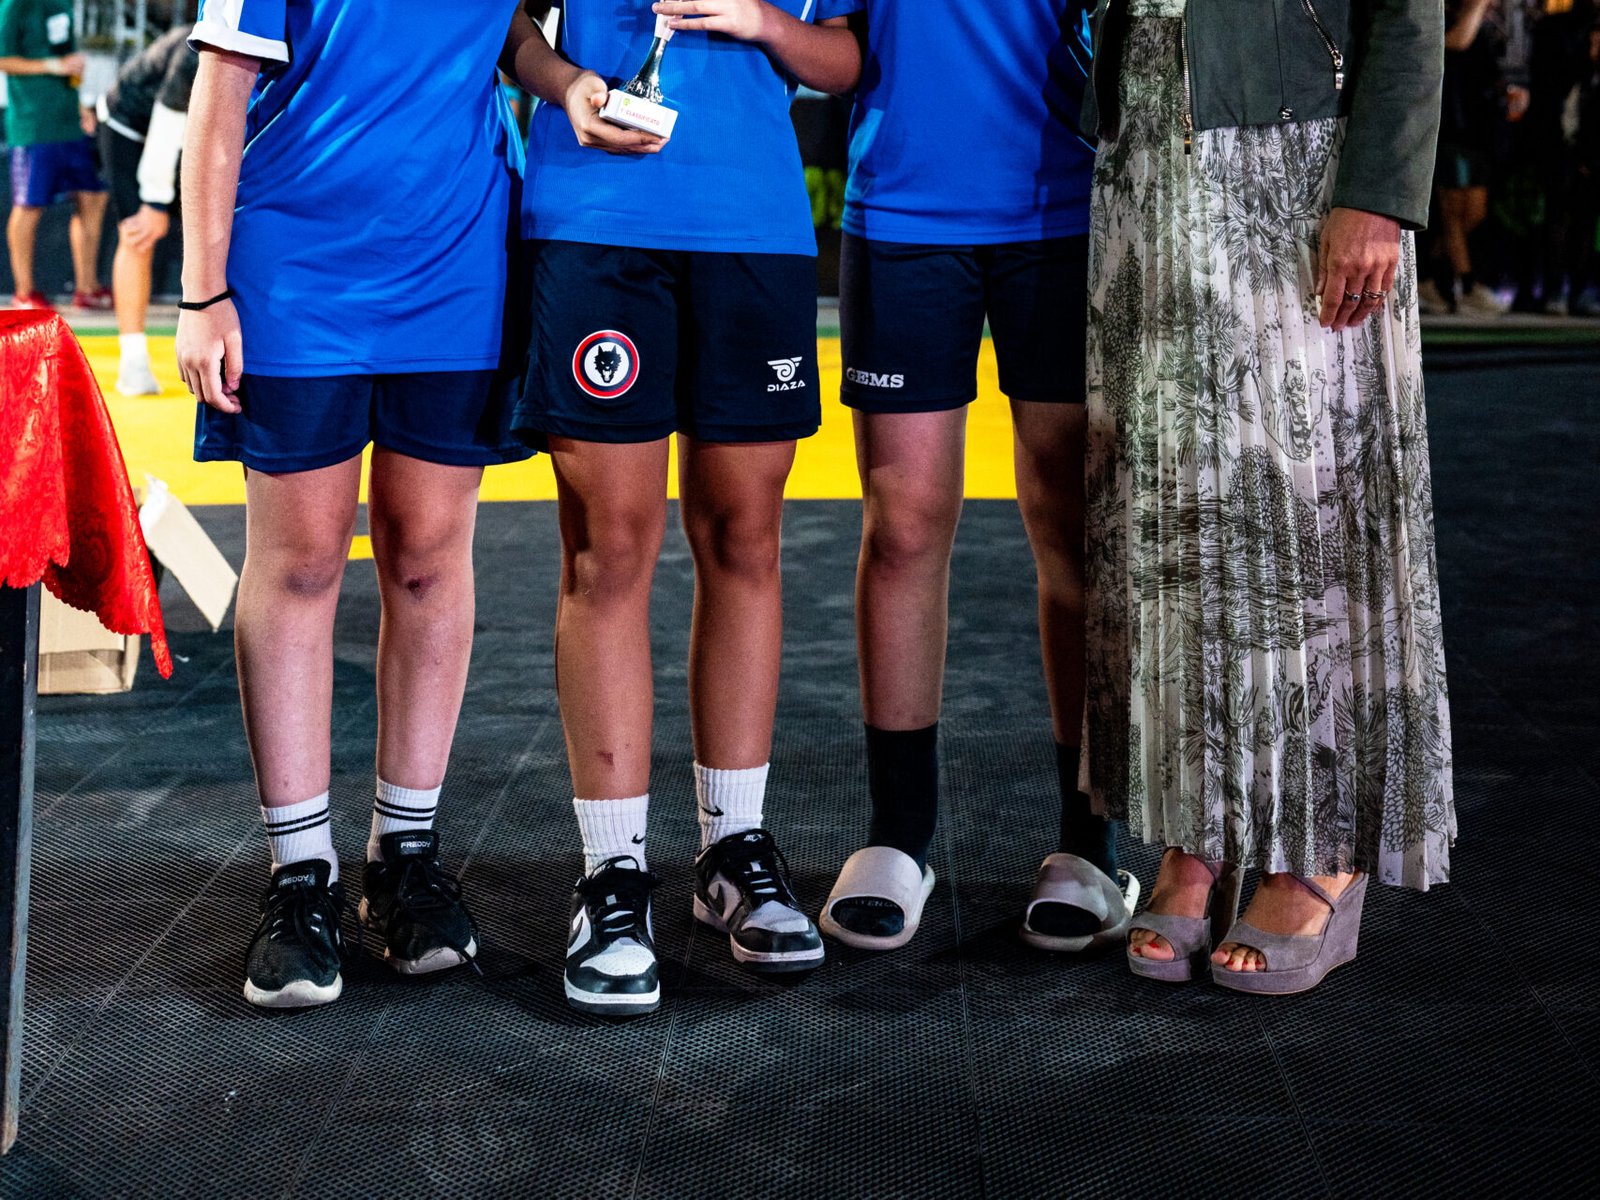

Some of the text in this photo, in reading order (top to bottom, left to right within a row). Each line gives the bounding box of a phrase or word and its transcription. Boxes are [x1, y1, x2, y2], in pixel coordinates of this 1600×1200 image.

[847, 367, 904, 388] GEMS
[767, 380, 806, 392] DIAZA
[400, 841, 431, 849] FREDDY
